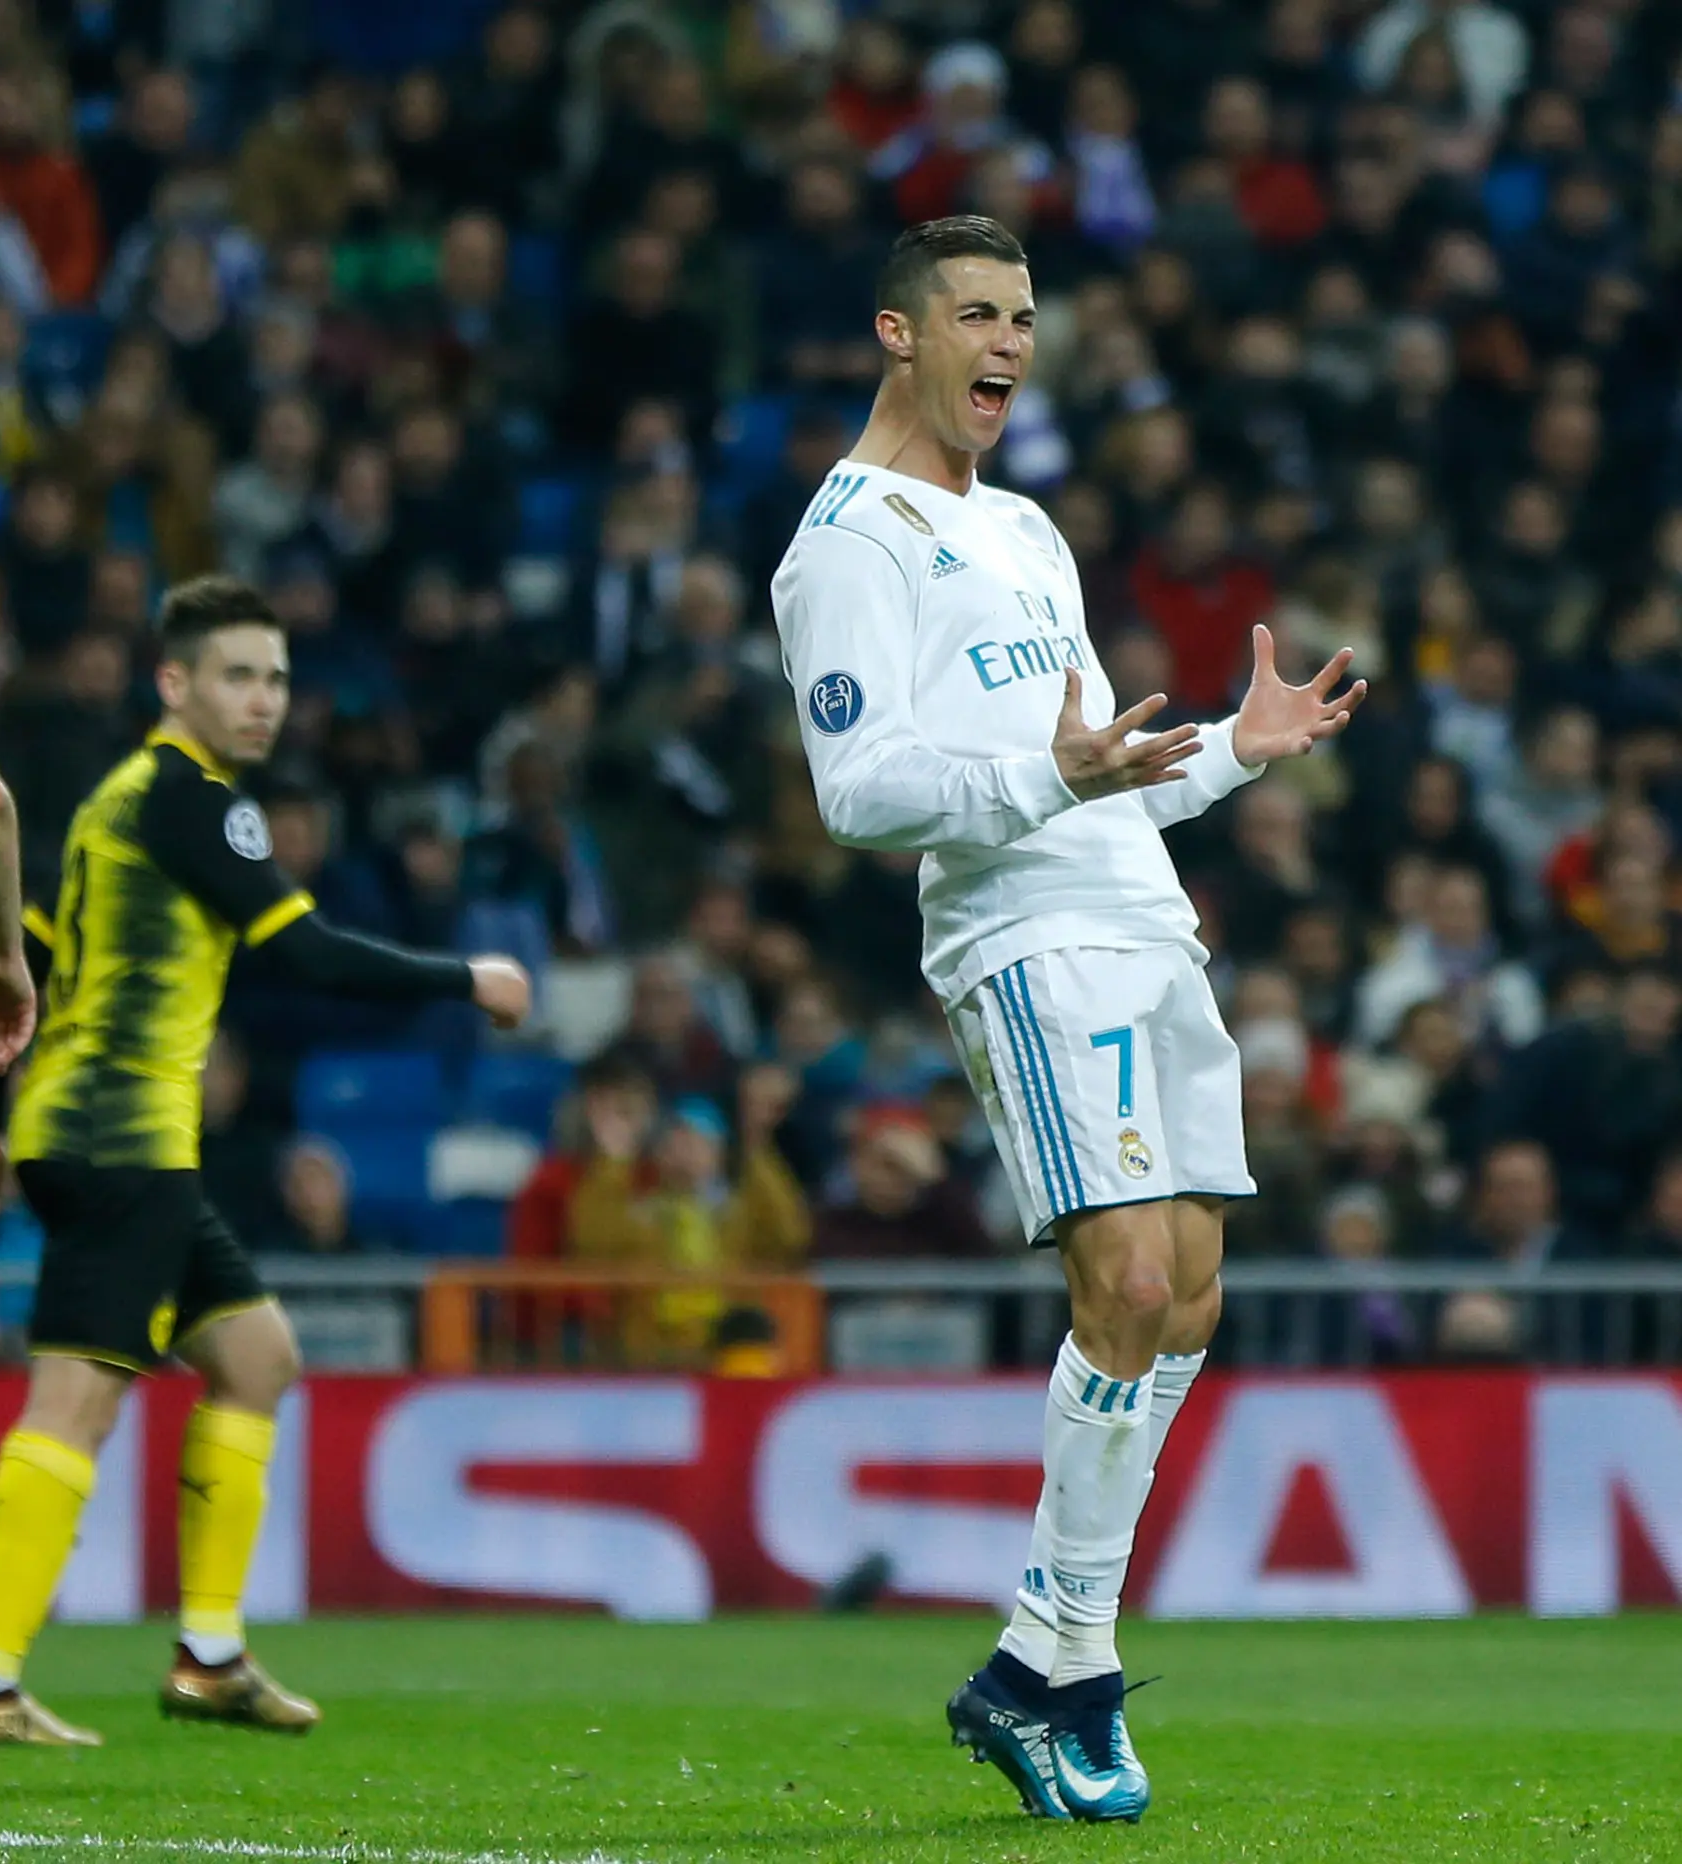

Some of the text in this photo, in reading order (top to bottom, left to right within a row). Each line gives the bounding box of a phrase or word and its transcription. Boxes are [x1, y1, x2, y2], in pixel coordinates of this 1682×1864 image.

[1014, 591, 1058, 627] Fly
[1089, 1024, 1133, 1118] 7
[989, 1711, 1014, 1729] CR7
